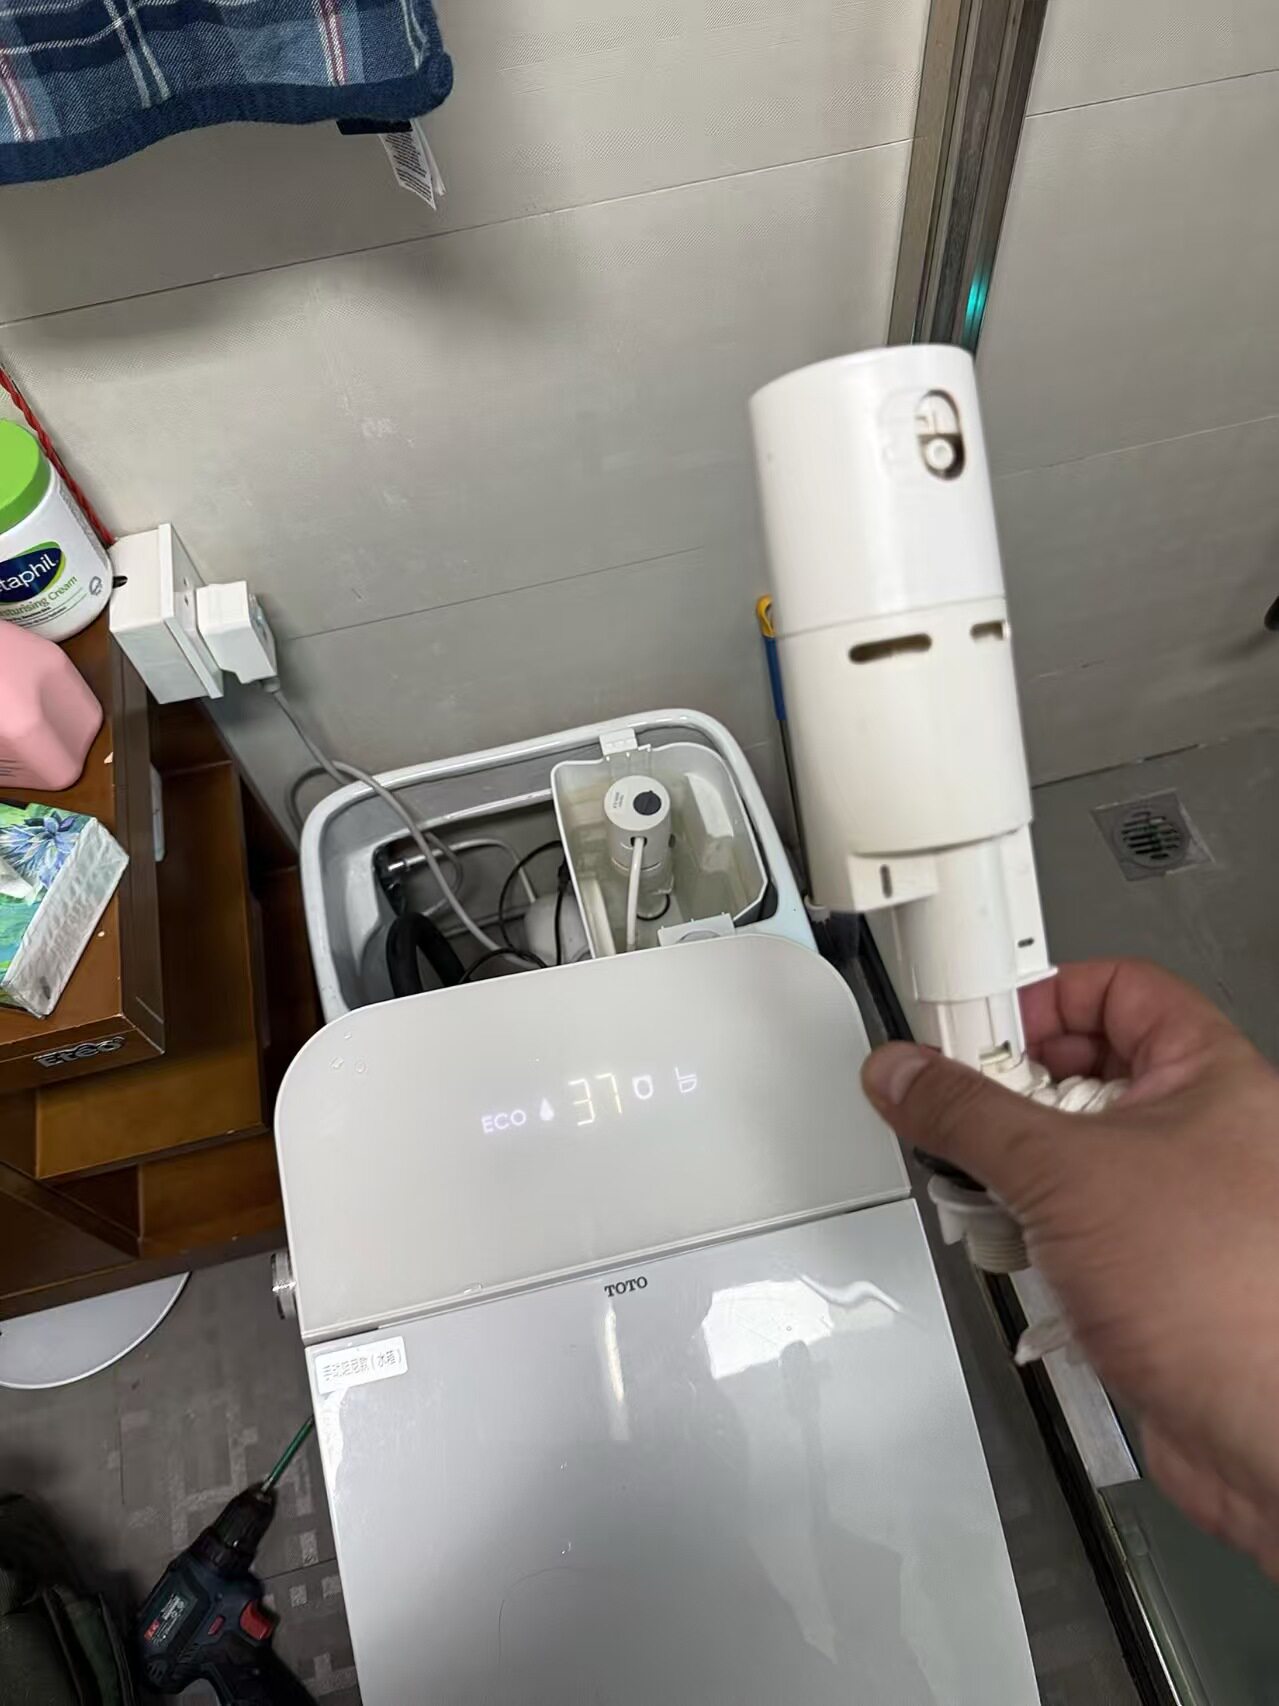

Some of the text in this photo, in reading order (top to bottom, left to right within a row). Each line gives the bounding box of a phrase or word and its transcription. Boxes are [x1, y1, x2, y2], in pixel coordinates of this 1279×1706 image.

[0, 553, 57, 592] taphil
[48, 576, 78, 600] Cream
[481, 1072, 622, 1134] ECO 37
[604, 1276, 648, 1298] TOTO
